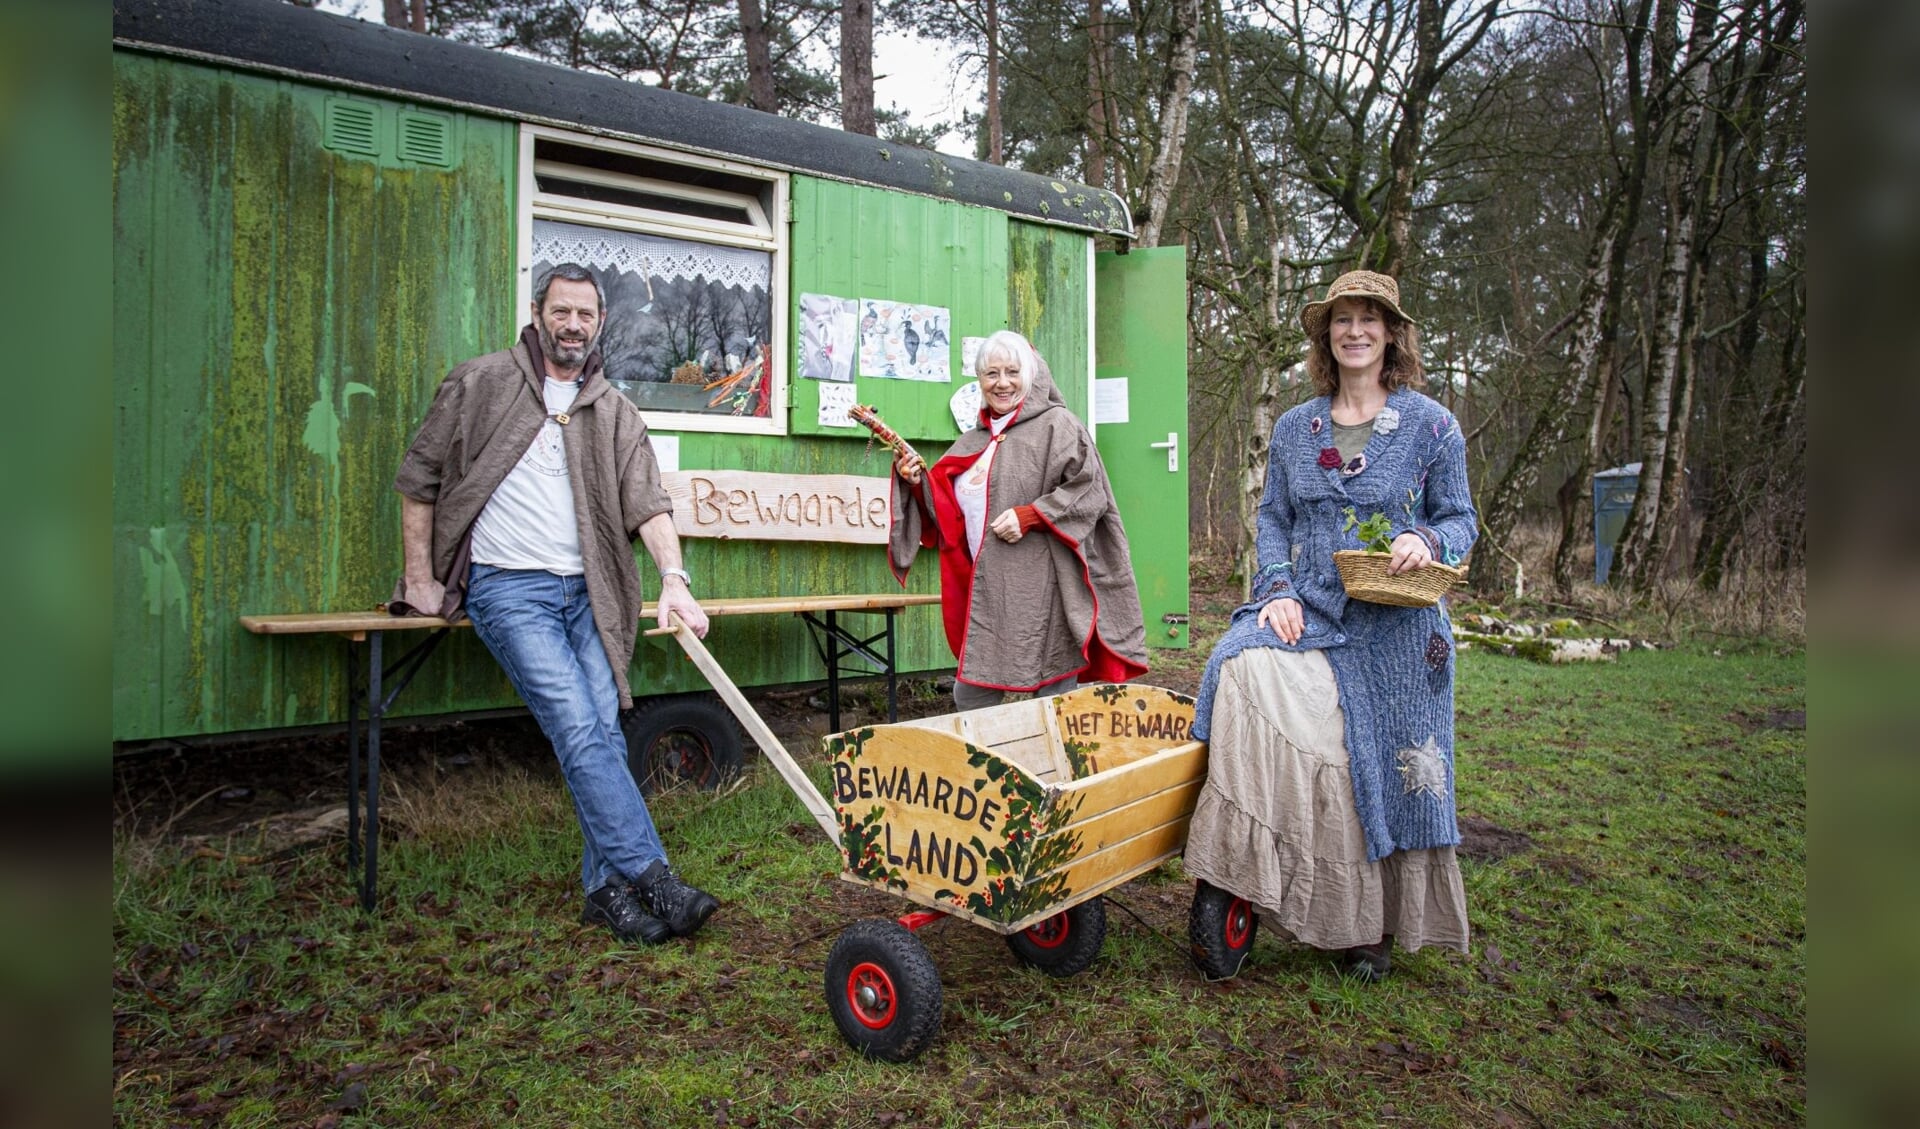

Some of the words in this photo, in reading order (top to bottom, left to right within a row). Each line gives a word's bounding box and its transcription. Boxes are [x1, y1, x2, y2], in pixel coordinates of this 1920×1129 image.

[690, 477, 886, 529] Bewaarde
[1066, 712, 1104, 736] HET
[834, 761, 1001, 832] BEWAARDE
[885, 822, 978, 886] LAND
